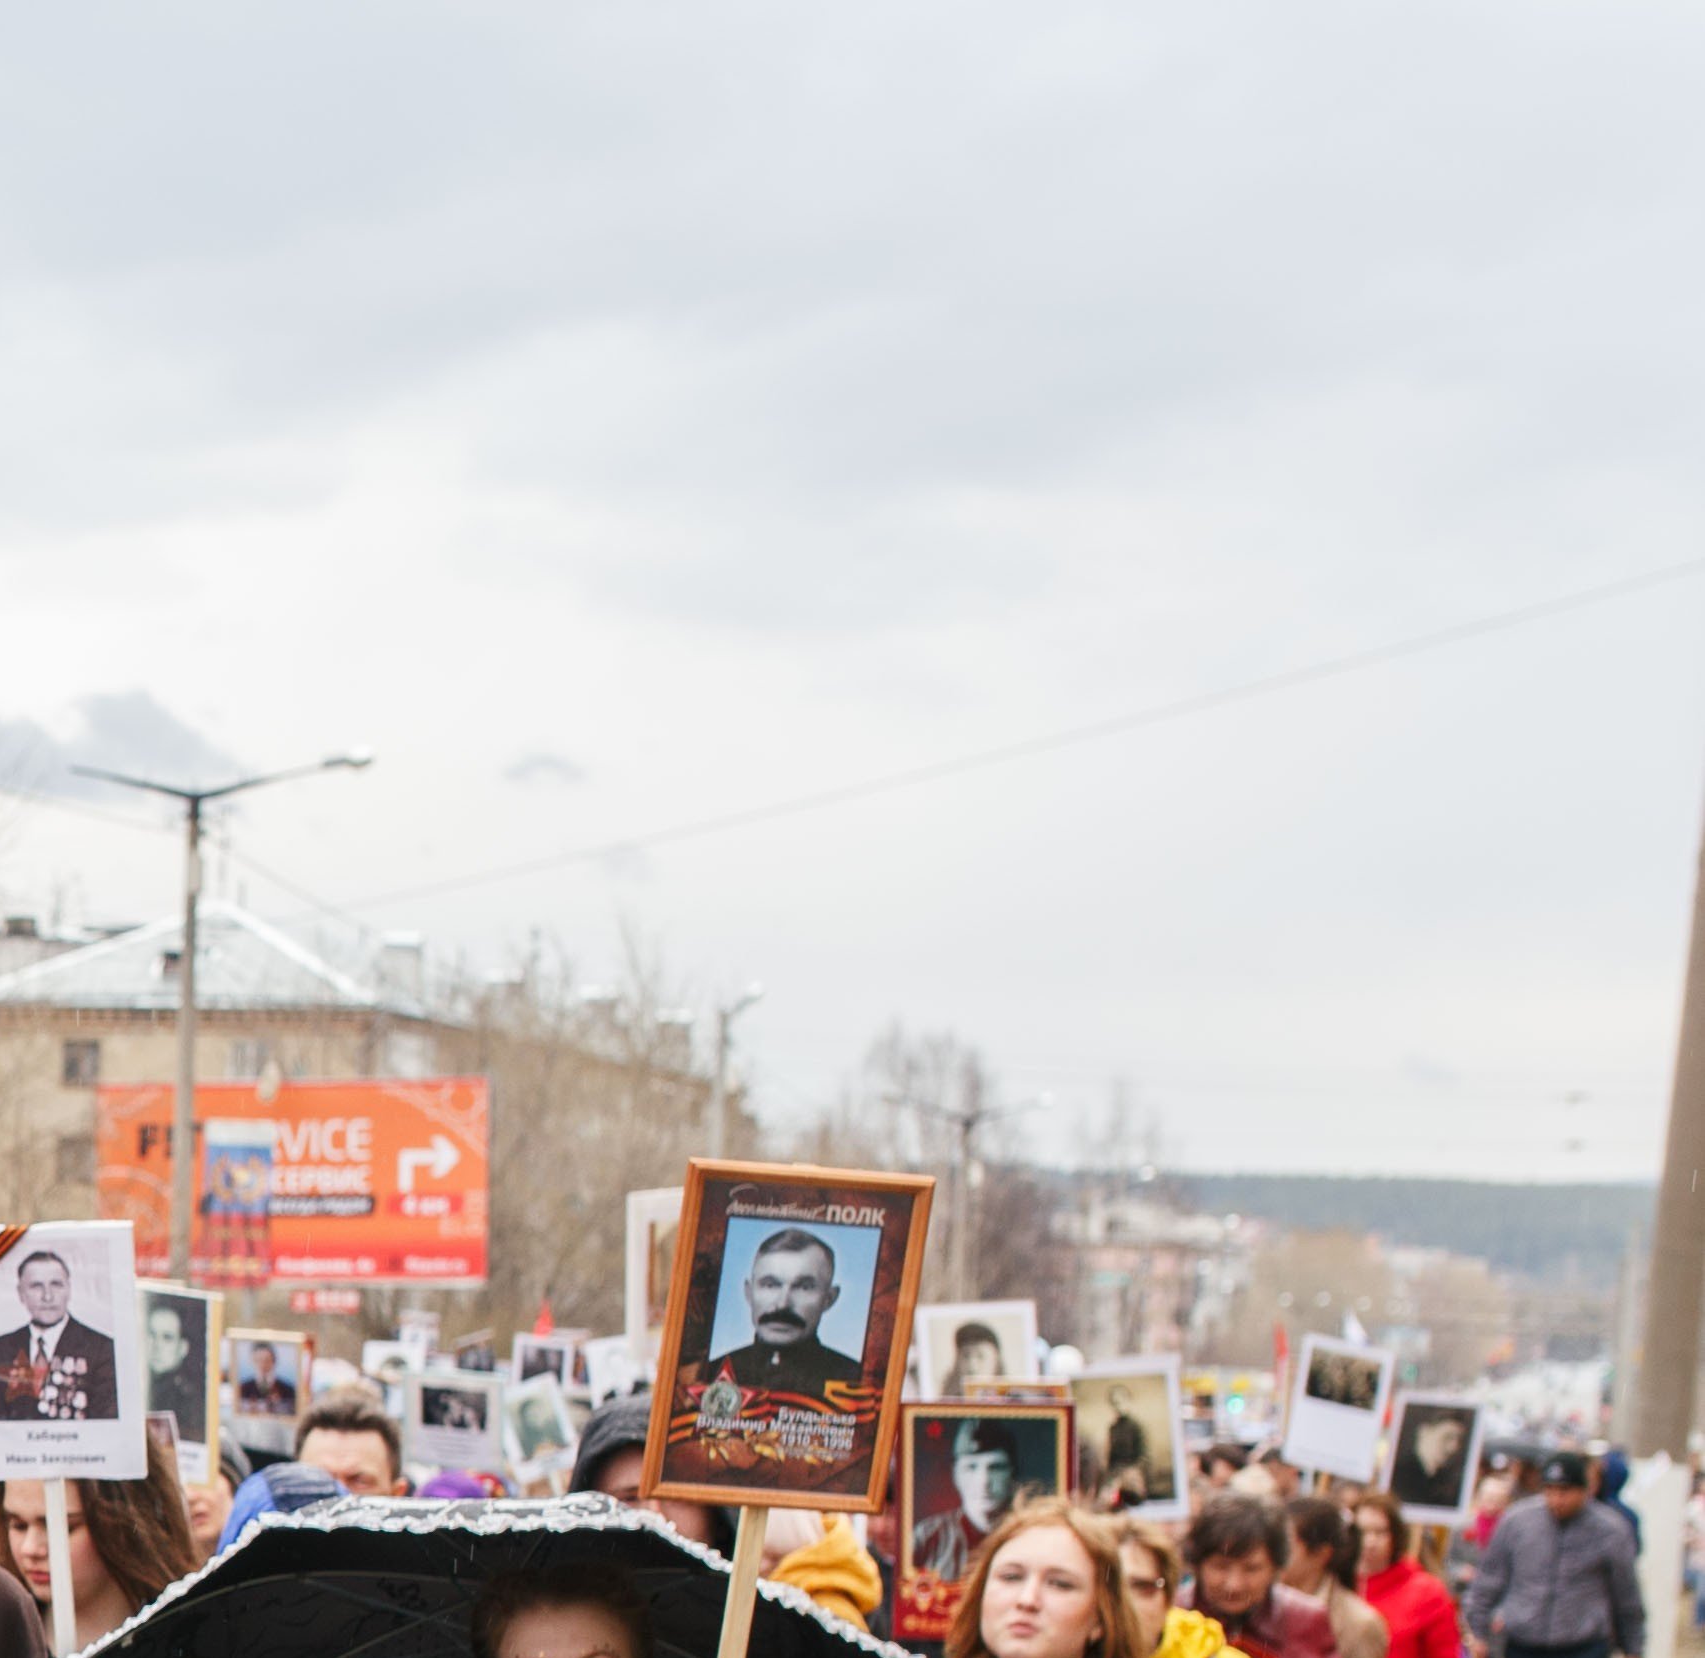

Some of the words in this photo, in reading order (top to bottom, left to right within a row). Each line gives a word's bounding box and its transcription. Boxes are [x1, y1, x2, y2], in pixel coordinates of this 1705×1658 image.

[826, 1204, 887, 1227] ПОЛК
[696, 1413, 767, 1434] Владимир
[769, 1418, 854, 1439] Михайлович
[5, 1453, 37, 1463] Иван
